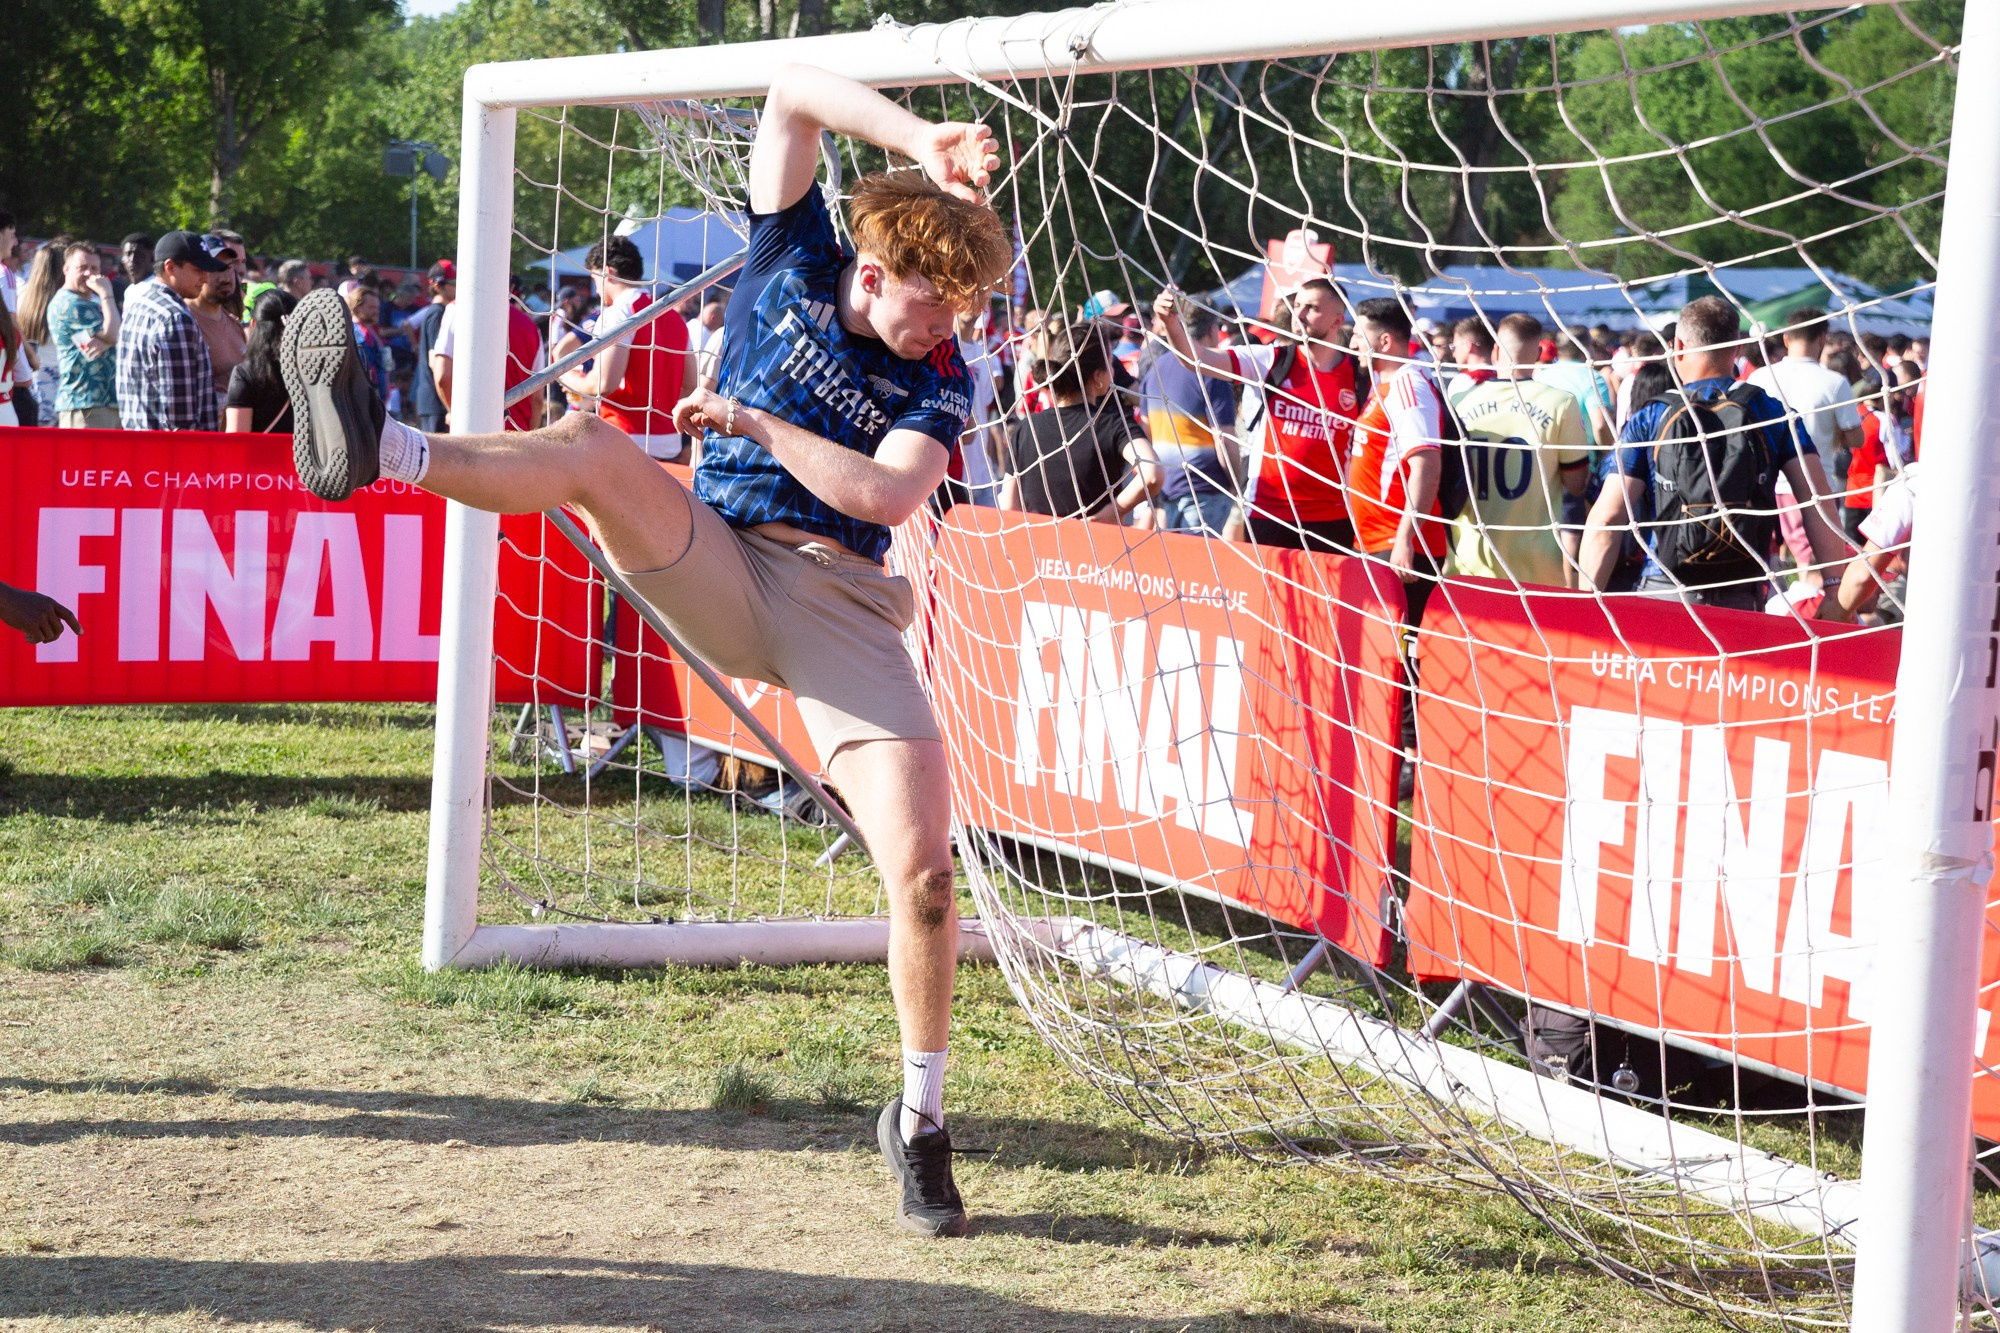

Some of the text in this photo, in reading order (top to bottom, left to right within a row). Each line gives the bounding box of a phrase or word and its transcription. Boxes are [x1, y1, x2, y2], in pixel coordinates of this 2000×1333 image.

[780, 350, 821, 385] FLY
[921, 398, 970, 427] RWAND
[939, 388, 969, 410] VISIT
[1461, 401, 1498, 426] MITH
[61, 470, 133, 488] UEFA
[1470, 437, 1533, 501] 10
[36, 507, 440, 663] FINAL
[1037, 558, 1249, 614] UEFA CHAMPIONS LEAGUE
[1591, 650, 1657, 684] UEFA
[1666, 662, 1840, 715] CHAMPIONS
[1014, 600, 1255, 850] FINAL
[1557, 705, 1890, 1026] FINA
